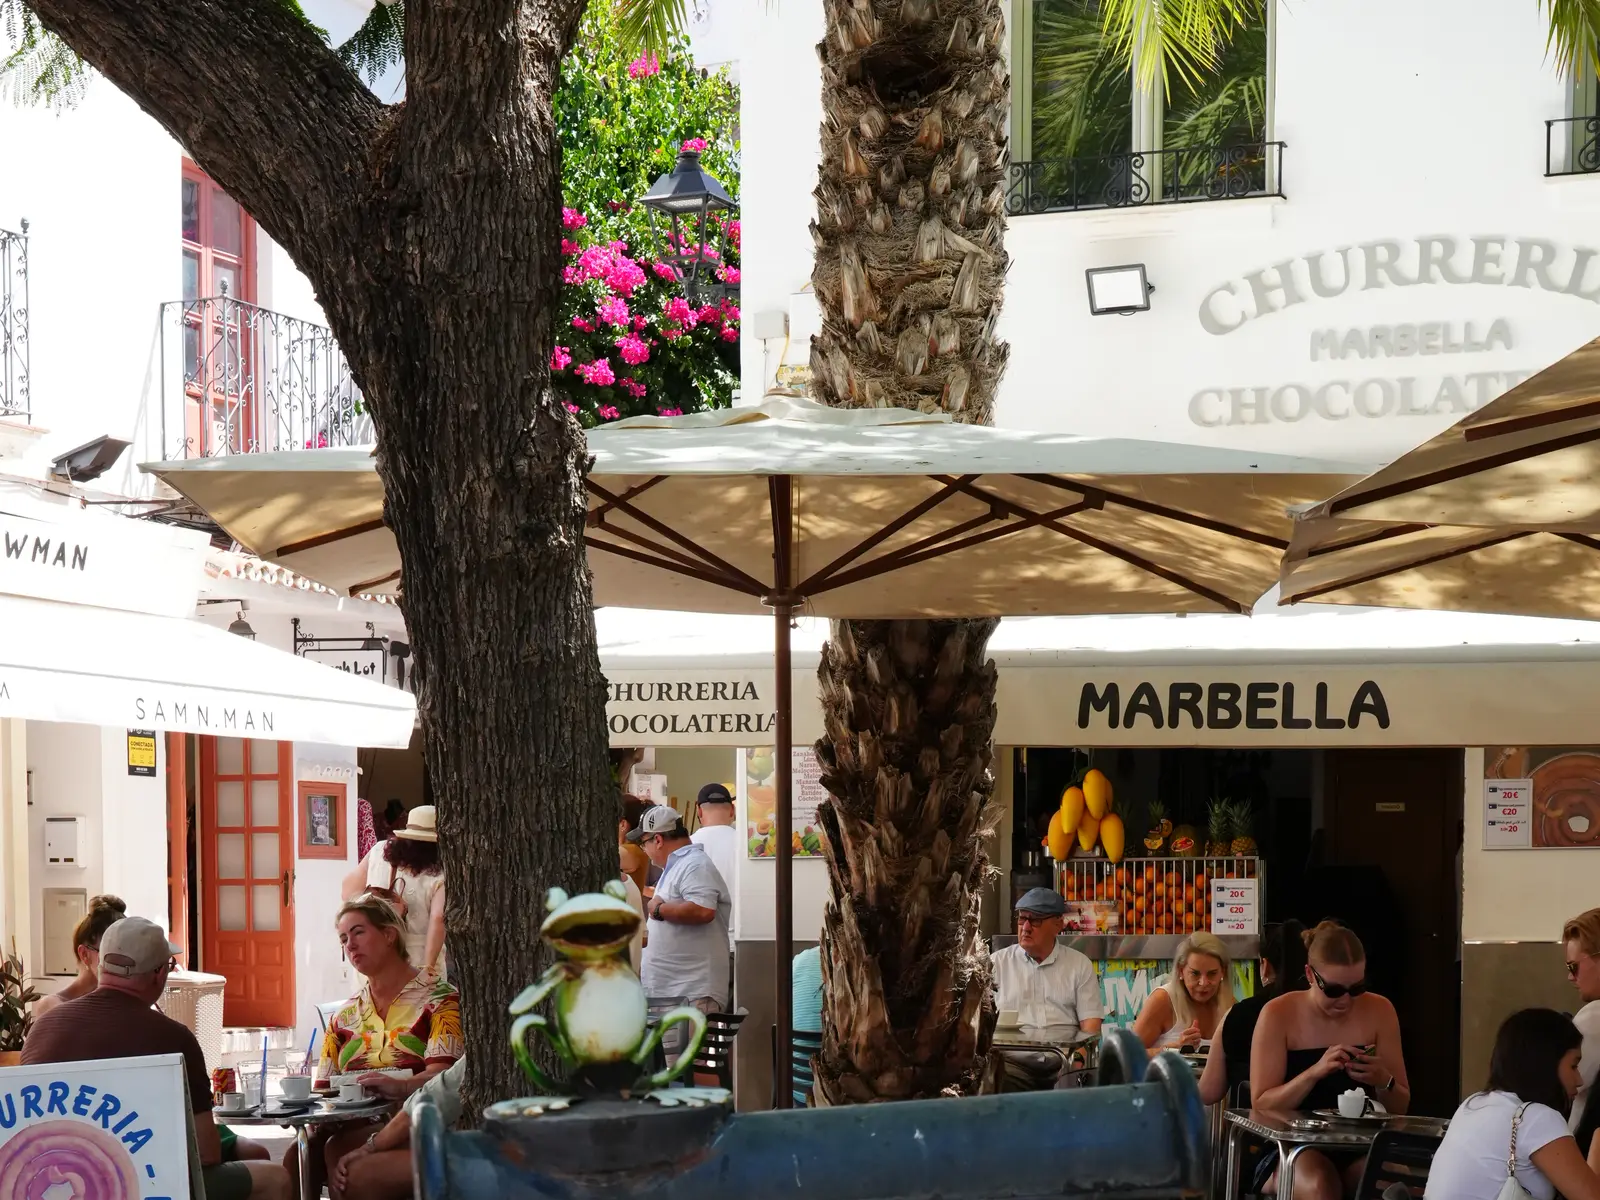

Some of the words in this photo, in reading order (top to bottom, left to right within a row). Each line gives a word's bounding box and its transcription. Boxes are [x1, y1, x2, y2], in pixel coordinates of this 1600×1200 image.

[1198, 233, 1600, 336] CHURRERI
[1309, 317, 1513, 362] MARBELLA
[608, 681, 760, 702] HURRERIA
[1077, 681, 1391, 730] MARBELLA
